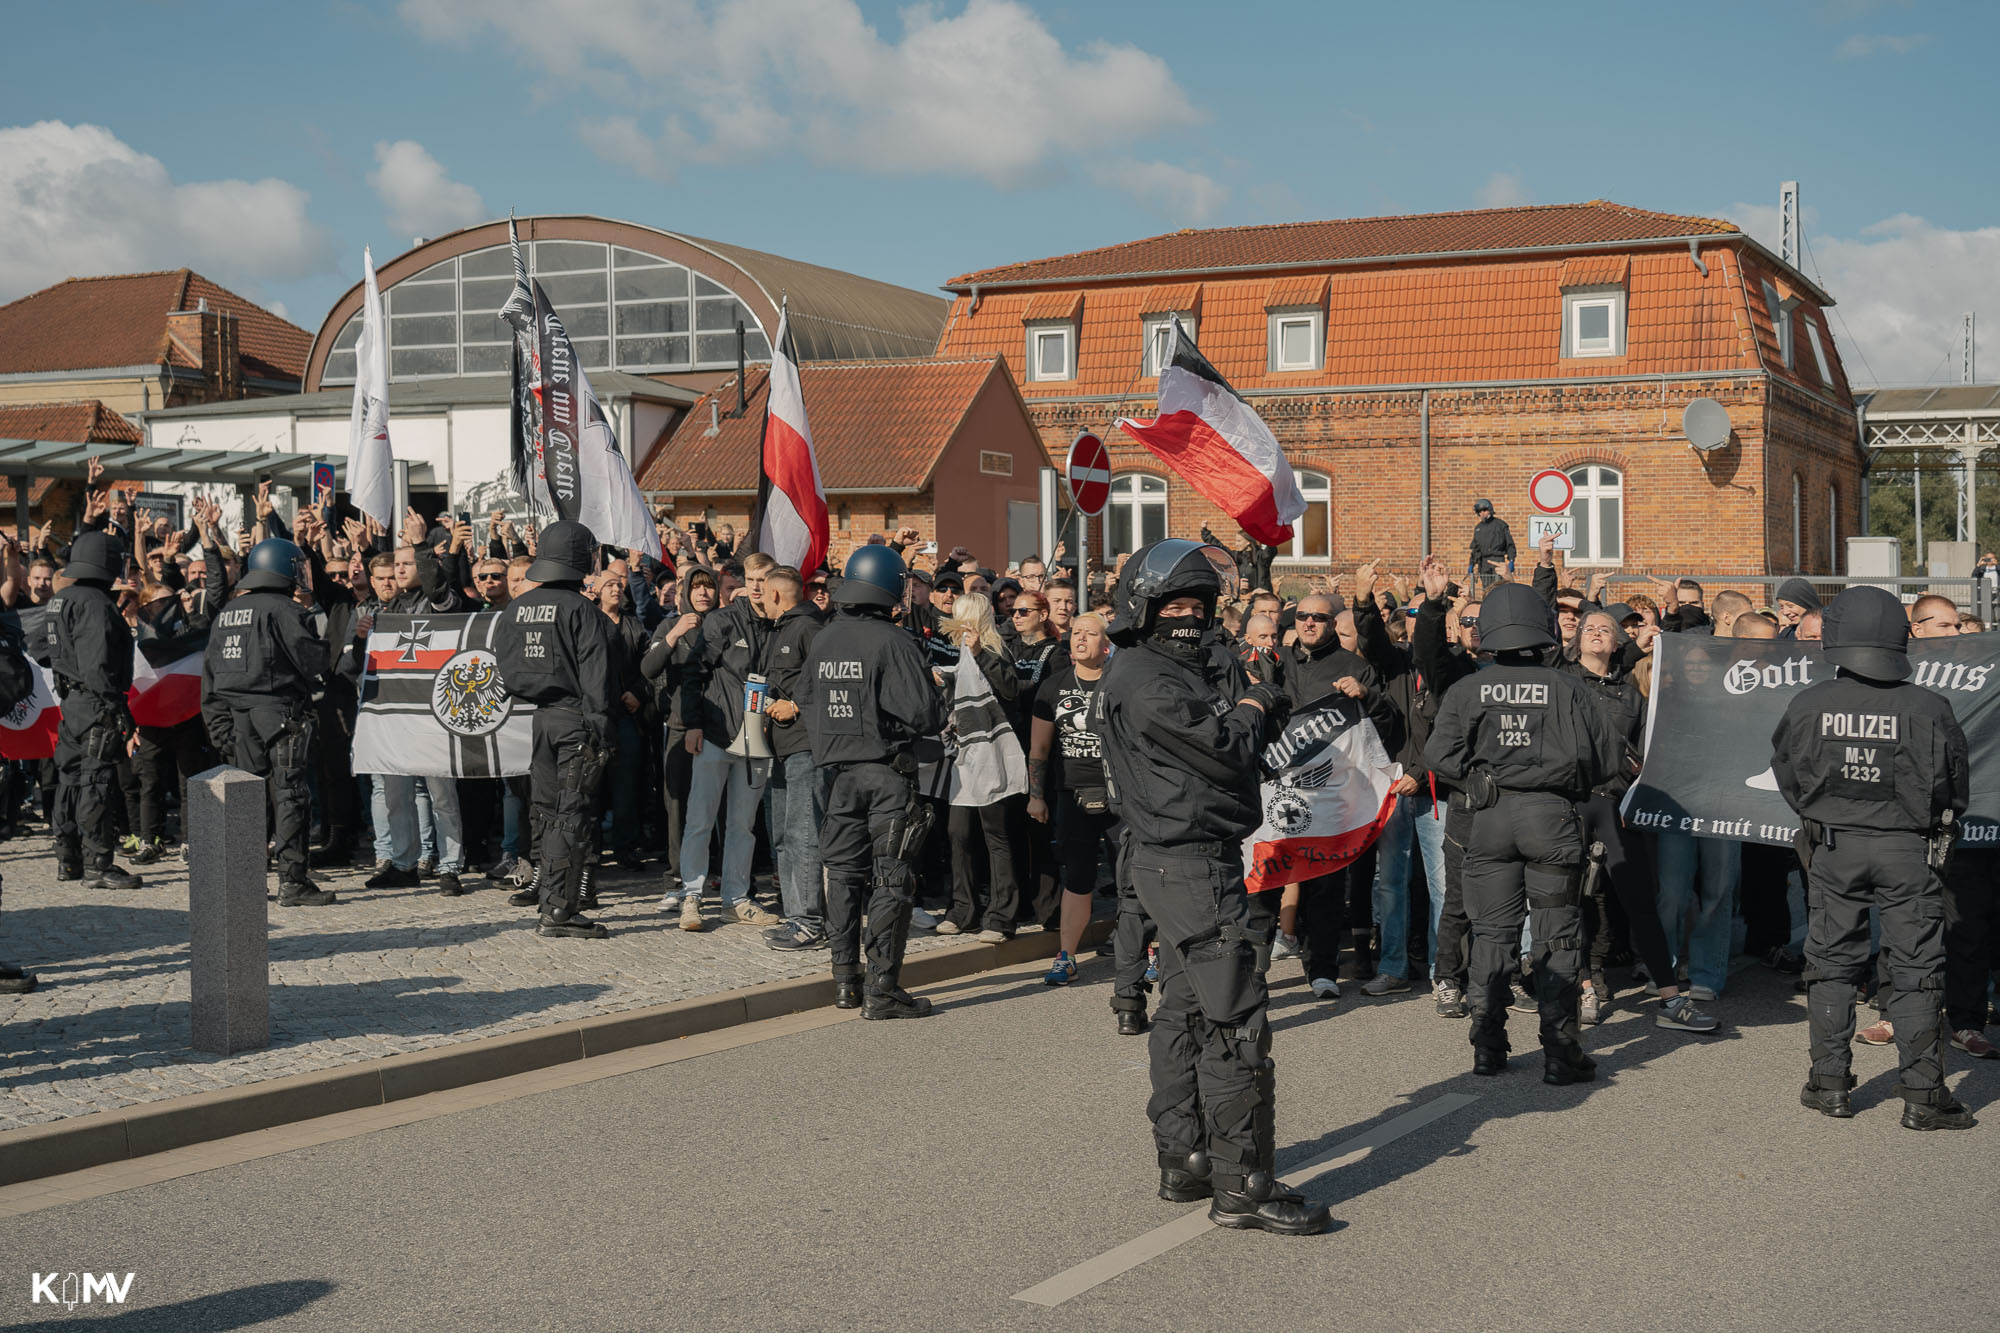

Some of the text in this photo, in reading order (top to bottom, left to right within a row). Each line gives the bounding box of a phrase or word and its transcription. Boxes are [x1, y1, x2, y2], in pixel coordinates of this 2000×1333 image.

[1535, 521, 1568, 535] TAXI
[218, 608, 253, 628] POLIZEI
[516, 604, 557, 623] POLIZEI
[222, 646, 242, 659] 1232
[524, 645, 546, 658] 1232
[818, 661, 864, 680] POLIZEI
[1723, 655, 1813, 695] Gott
[1914, 660, 1995, 692] uns
[829, 689, 849, 703] M-V
[1480, 683, 1549, 705] POLIZEI
[827, 704, 854, 718] 1233
[1500, 714, 1528, 730] M-V
[1821, 712, 1897, 740] POLIZEI
[1496, 731, 1532, 747] 1233
[1845, 746, 1877, 765] M-V
[1840, 764, 1881, 783] 1232
[1632, 807, 1673, 828] wie
[1680, 816, 1704, 832] er
[1712, 817, 1752, 836] mit
[1963, 821, 2000, 841] wa
